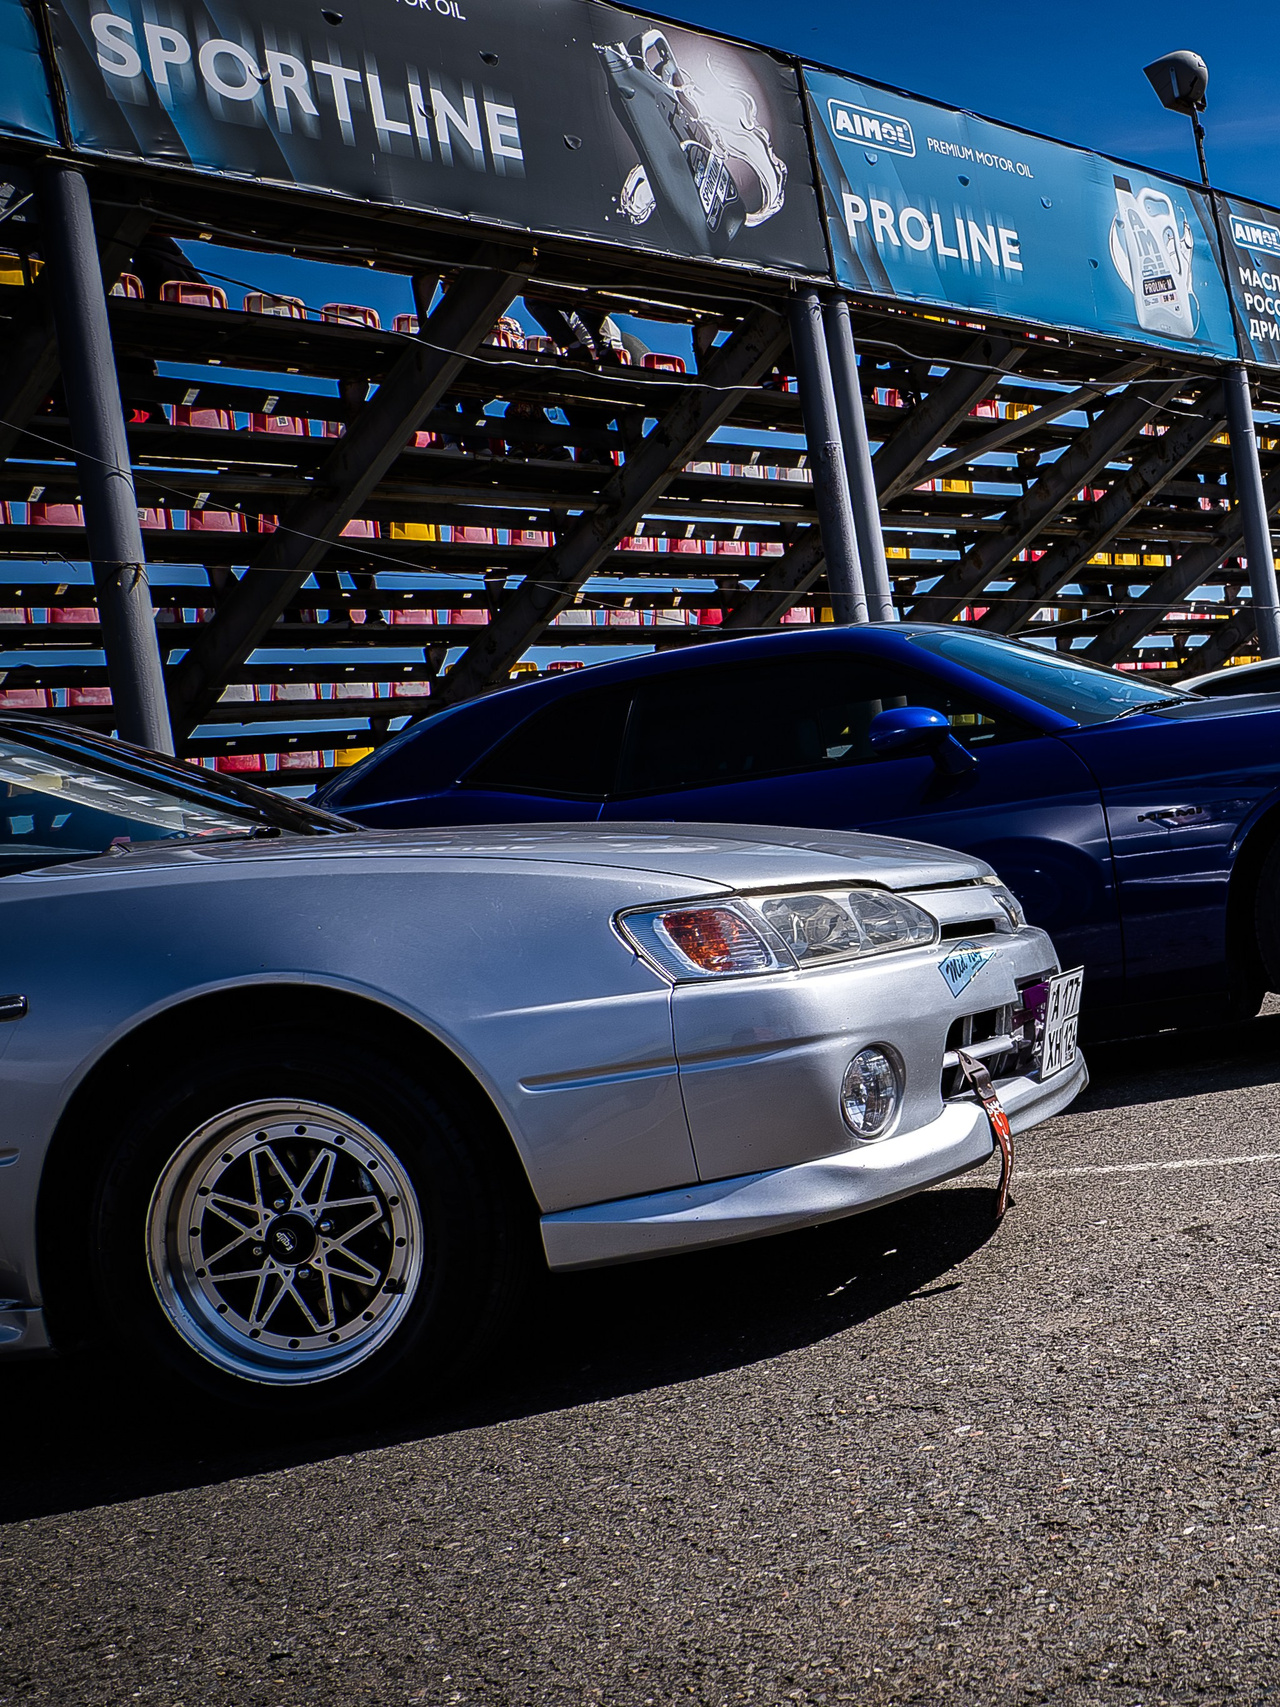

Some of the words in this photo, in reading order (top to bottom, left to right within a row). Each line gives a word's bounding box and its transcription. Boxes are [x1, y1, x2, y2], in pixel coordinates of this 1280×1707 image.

[90, 12, 524, 161] SPORTLINE
[835, 109, 912, 150] AIMOL
[927, 137, 974, 162] PREMIUM
[976, 151, 1015, 174] MOTOR
[1016, 162, 1034, 179] OIL
[841, 192, 1024, 271] PROLINE
